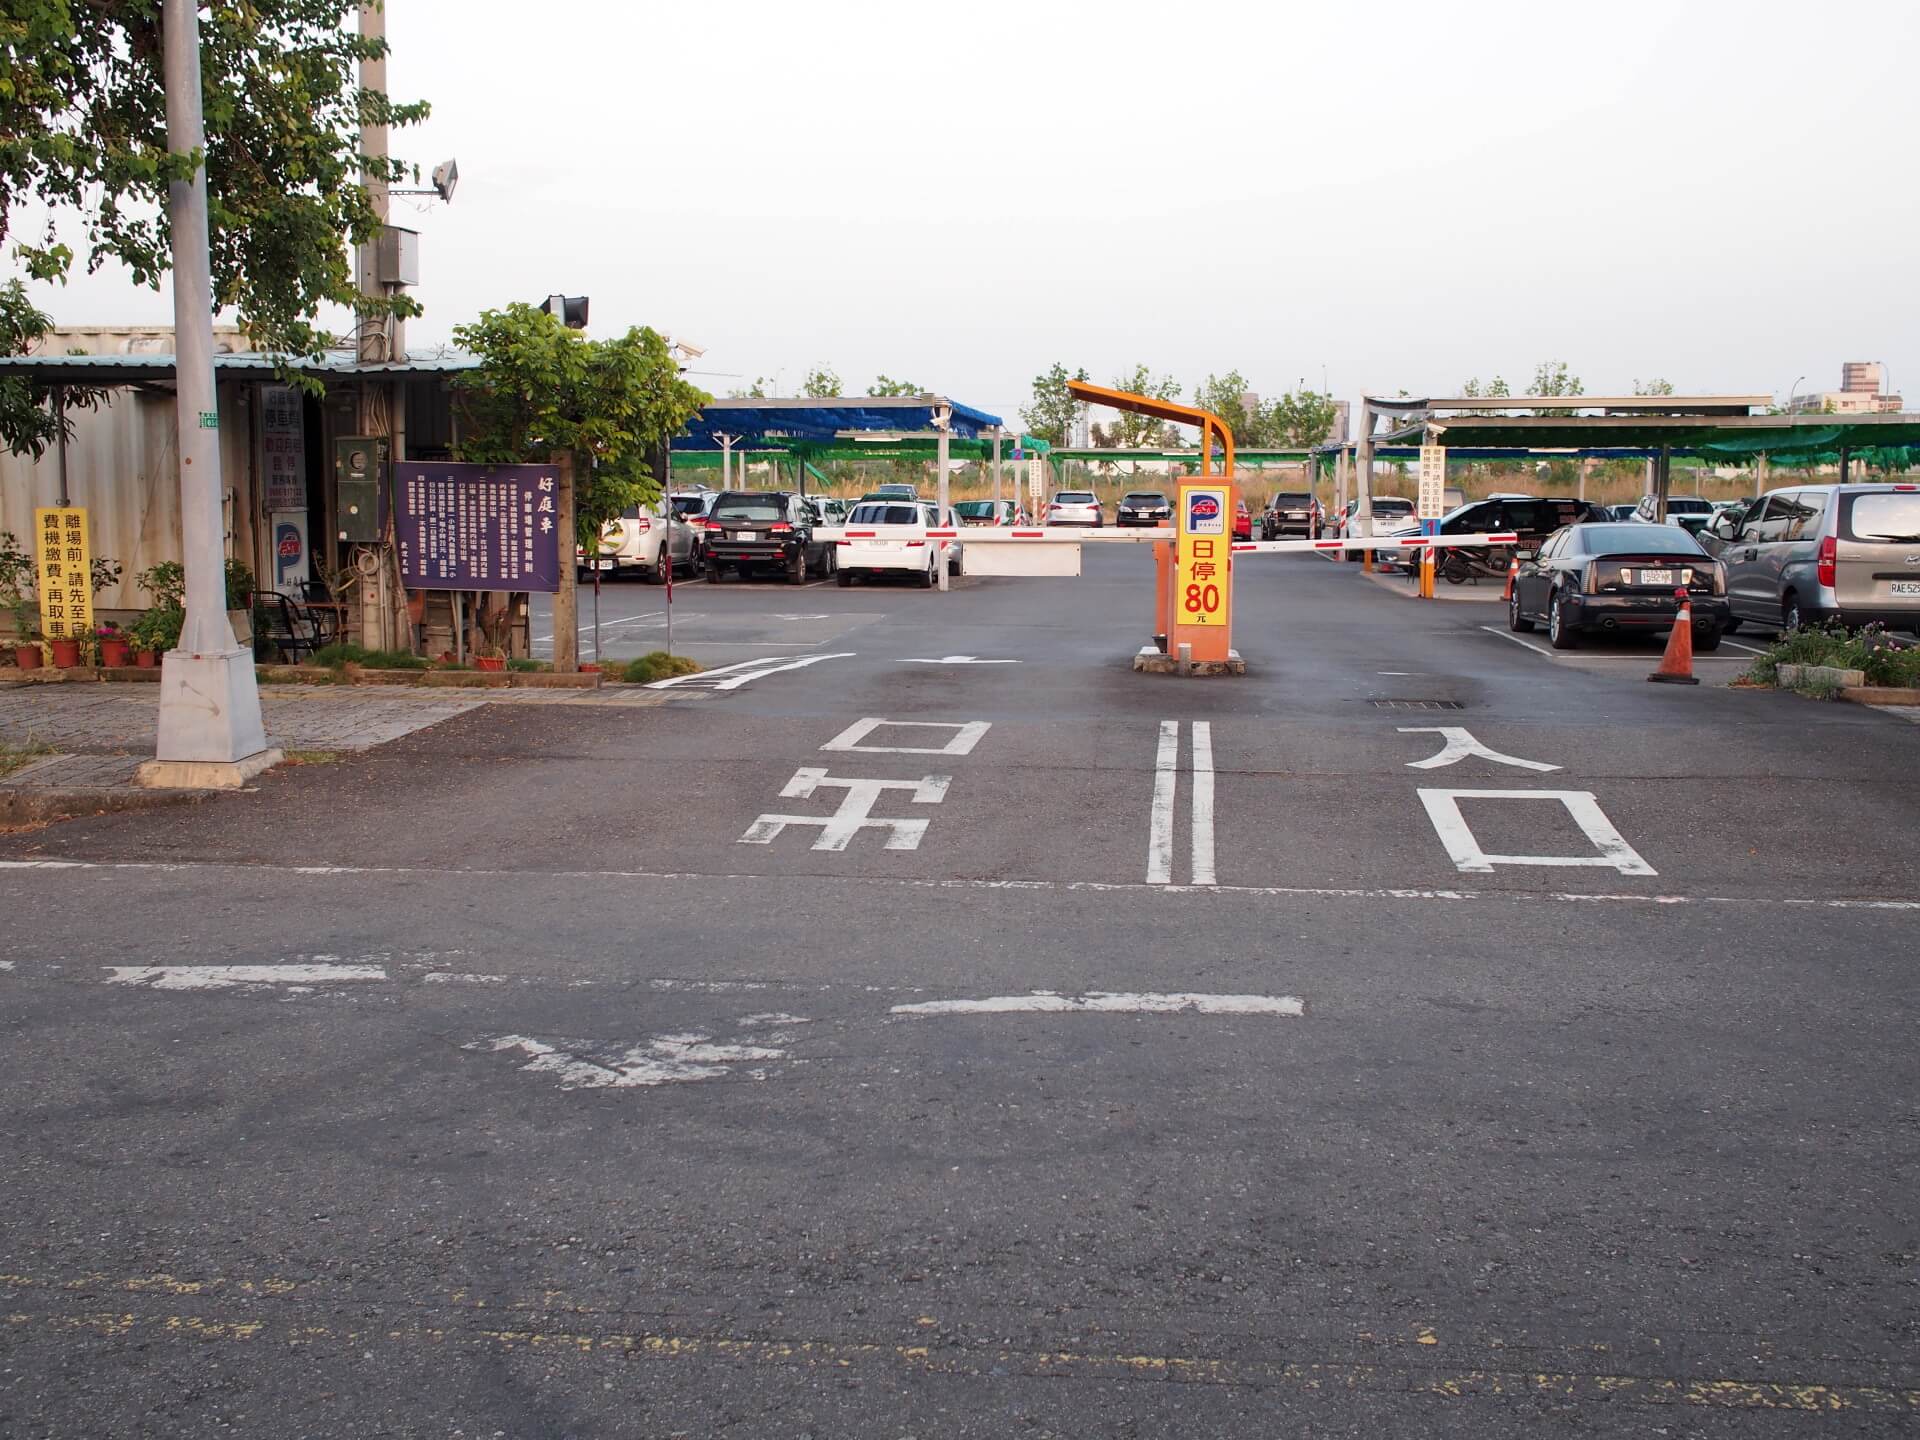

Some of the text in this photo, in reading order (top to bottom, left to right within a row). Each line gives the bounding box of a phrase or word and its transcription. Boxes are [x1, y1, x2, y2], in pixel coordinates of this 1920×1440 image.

[1012, 449, 1022, 460] 2
[538, 477, 555, 534] 好庭車
[1425, 520, 1435, 536] 1
[1184, 583, 1220, 613] 80
[1197, 613, 1207, 623] 元
[1396, 726, 1659, 876] 入口
